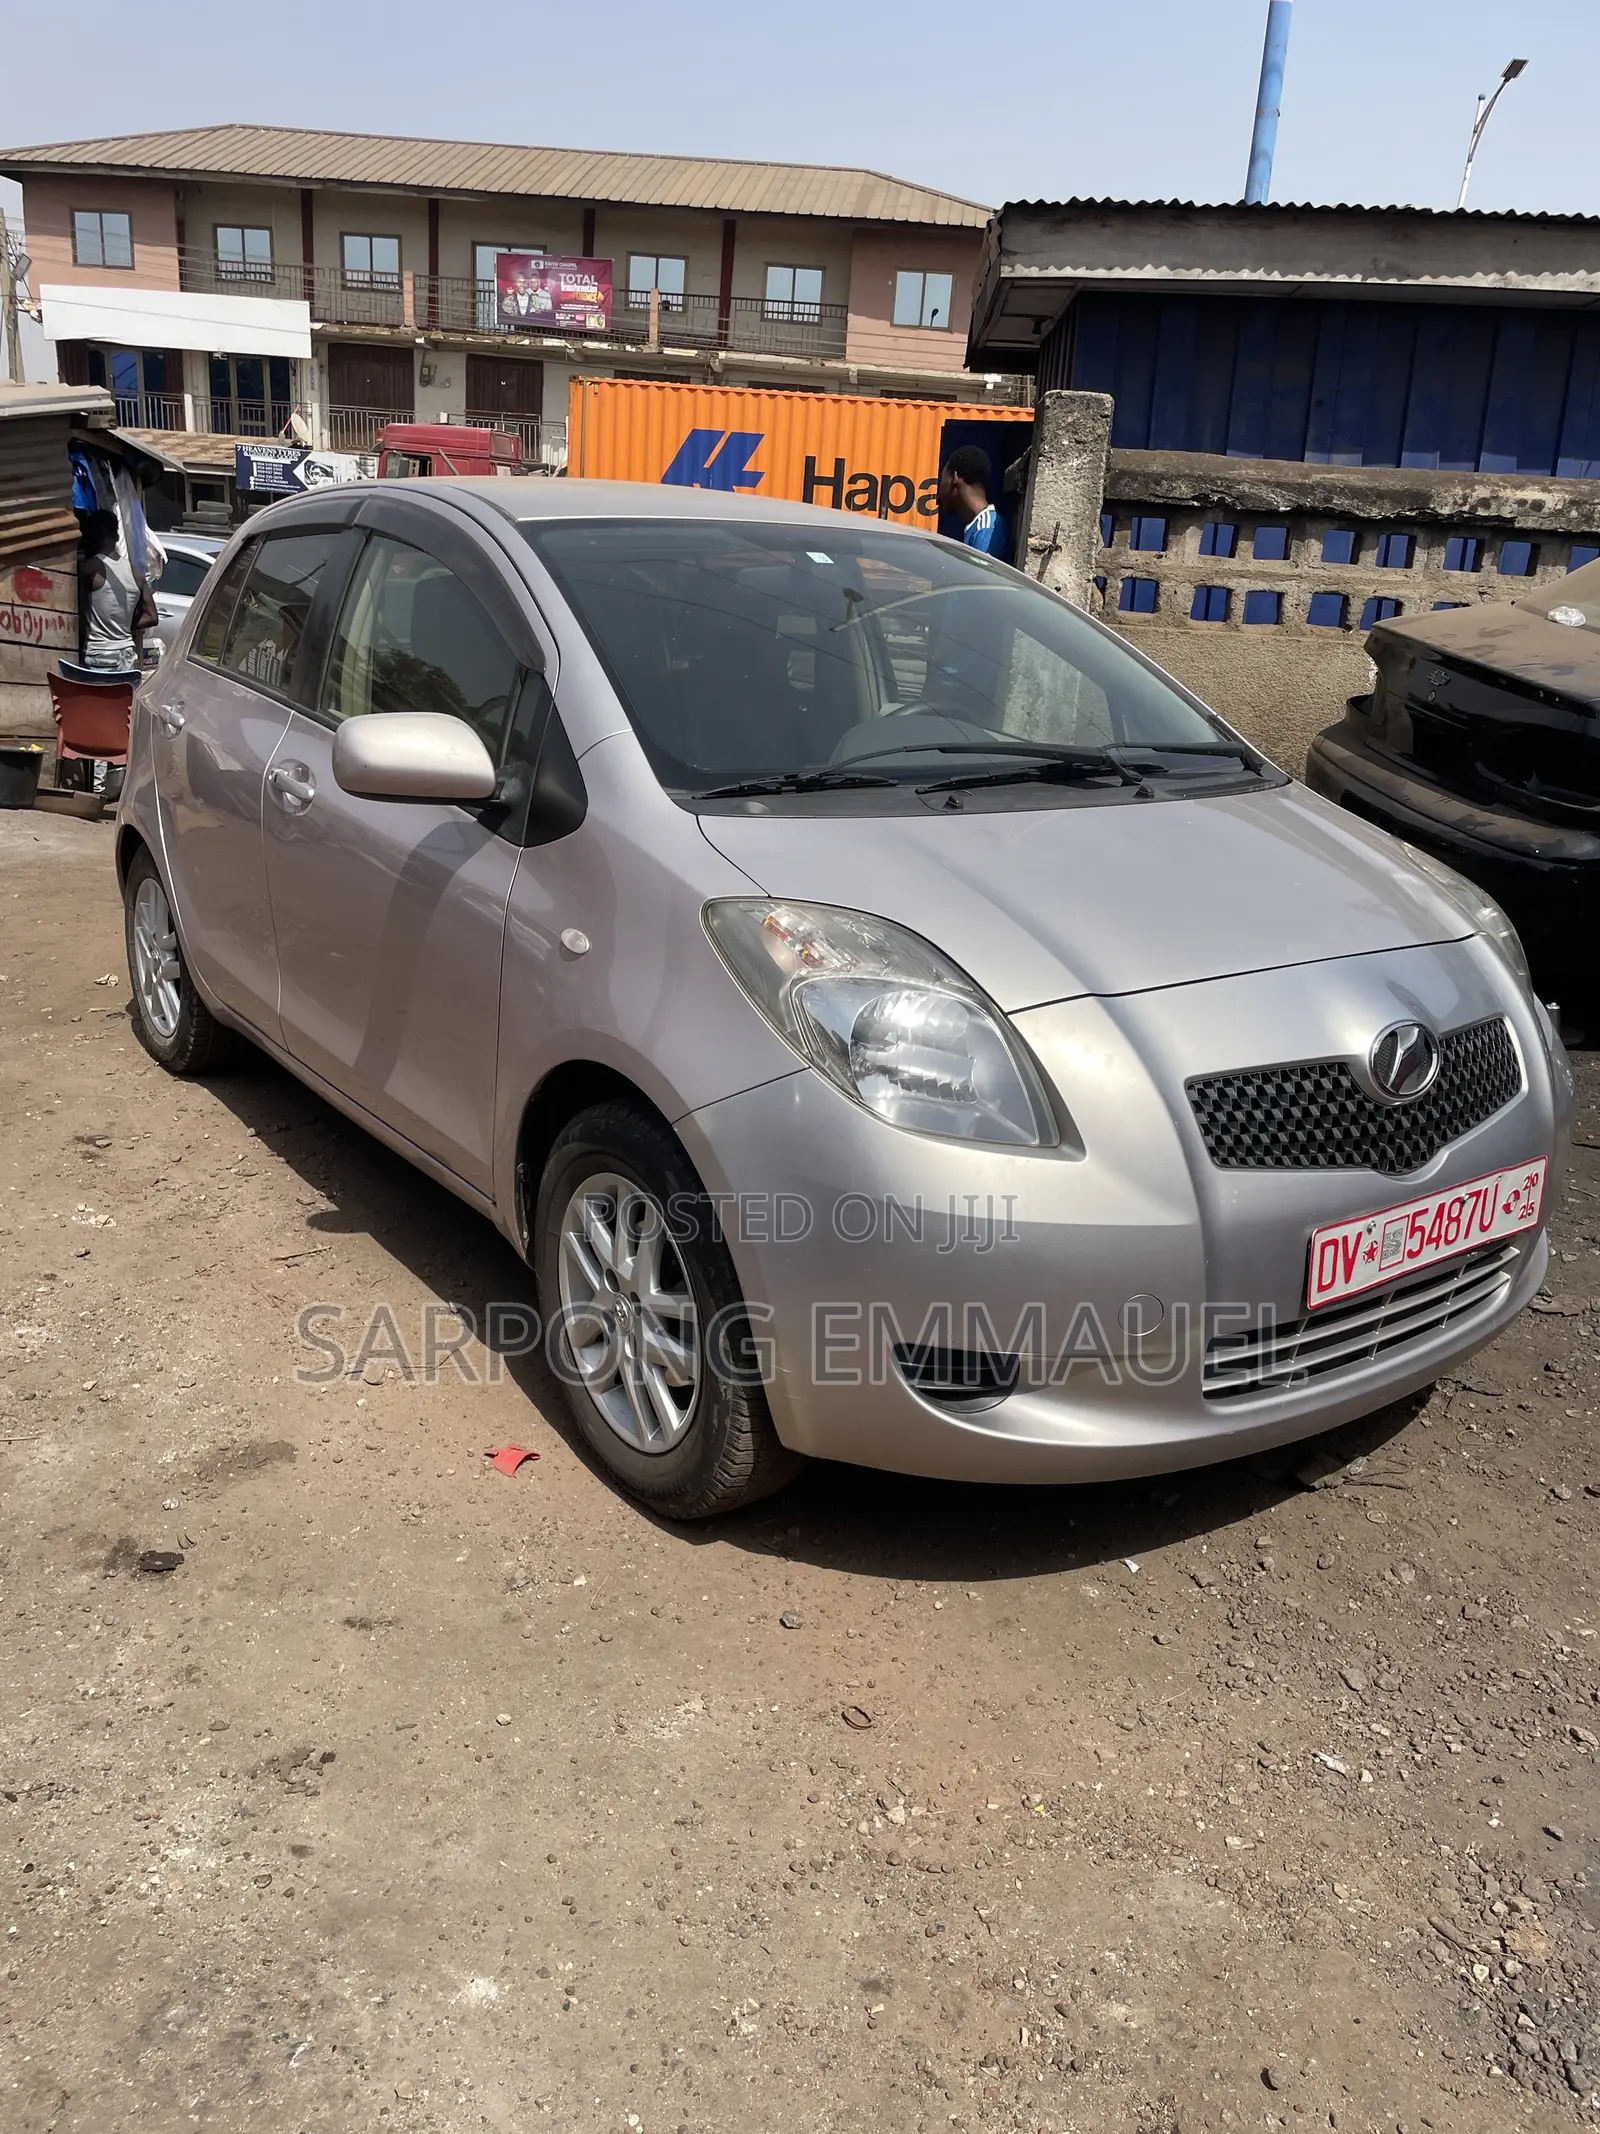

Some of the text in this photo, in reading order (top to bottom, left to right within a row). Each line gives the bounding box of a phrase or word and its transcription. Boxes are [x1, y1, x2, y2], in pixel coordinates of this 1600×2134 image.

[559, 273, 598, 285] TOTAL
[242, 446, 277, 455] HEAVENS
[278, 449, 301, 457] TYRES
[803, 456, 940, 520] Hapa
[1522, 1171, 1539, 1191] 20
[1518, 1202, 1535, 1220] 25
[1317, 1182, 1499, 1293] DV 5487U
